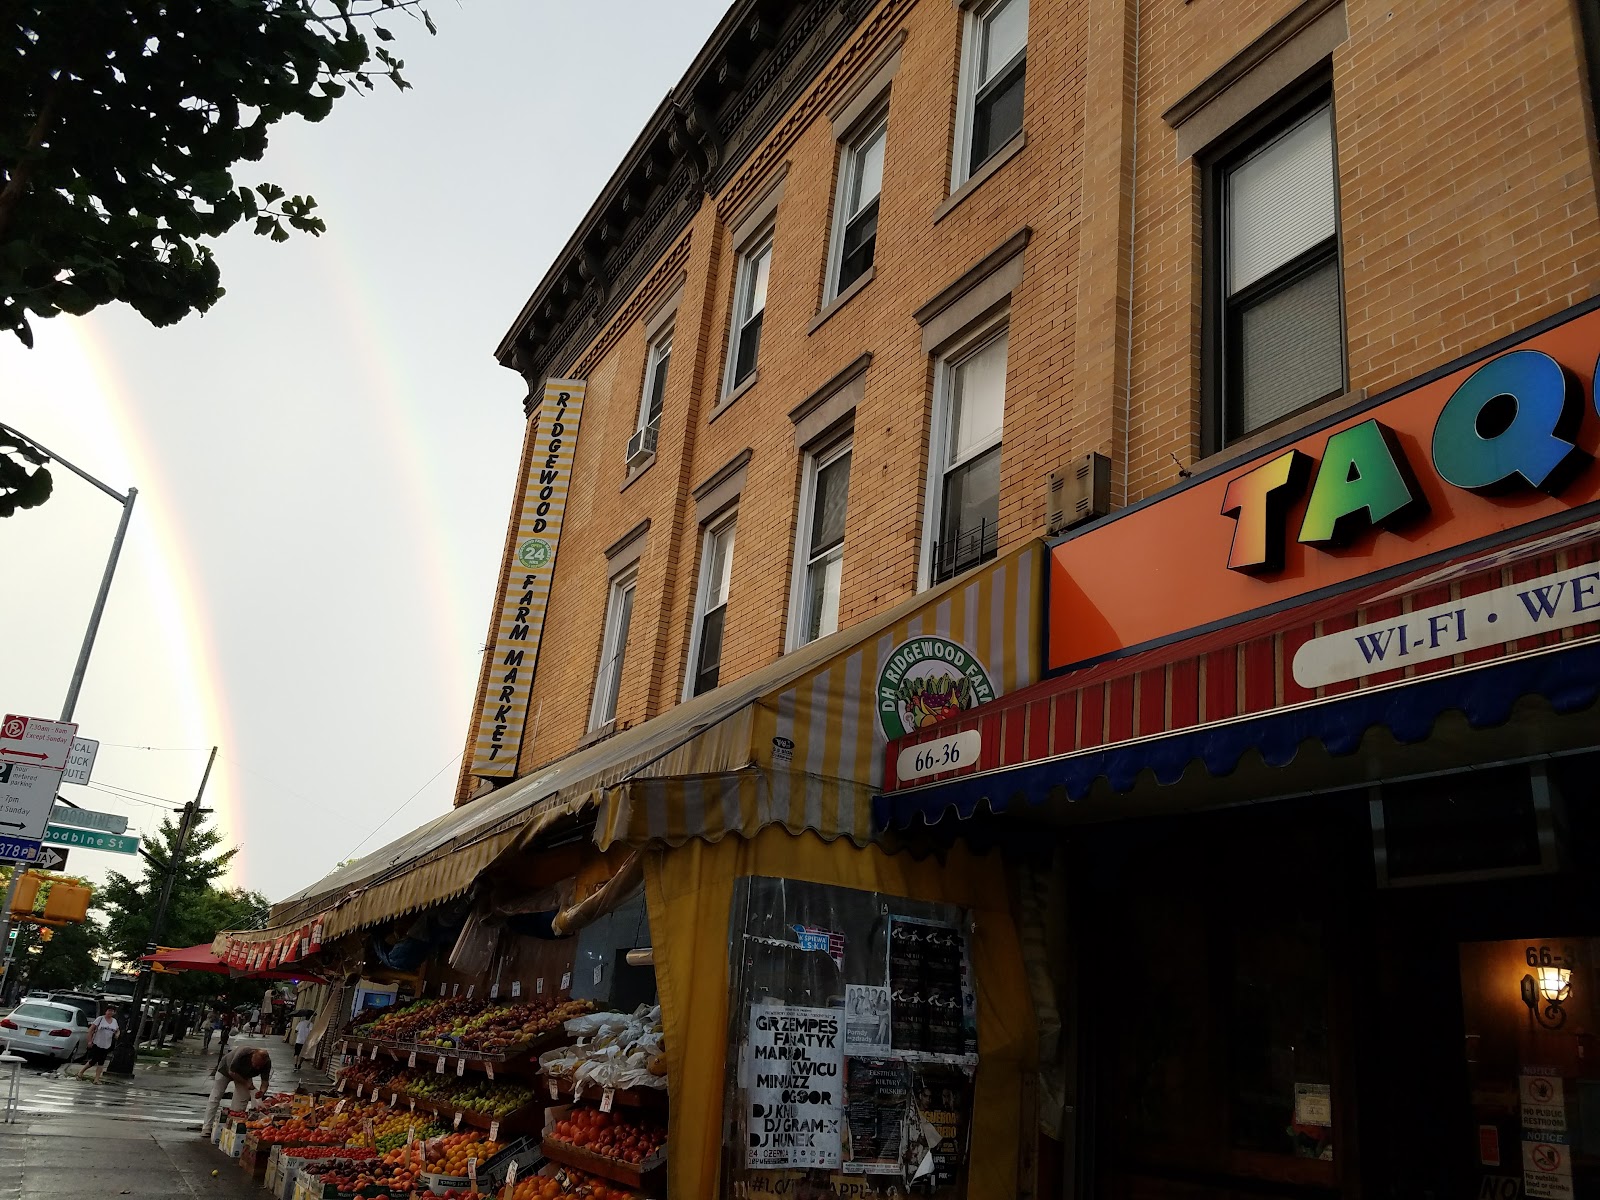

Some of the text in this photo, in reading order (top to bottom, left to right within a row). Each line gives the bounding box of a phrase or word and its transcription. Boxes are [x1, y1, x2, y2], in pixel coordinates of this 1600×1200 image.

[533, 392, 571, 533] RIDGEWOOD
[1220, 349, 1600, 570] TAQ
[524, 547, 545, 560] 24
[509, 574, 536, 641] FARM
[1355, 608, 1468, 664] WI-FI
[885, 641, 965, 684] RIDGEWOOD
[488, 650, 525, 761] MARKET
[882, 687, 896, 712] DH
[25, 732, 68, 744] Except Sunday
[70, 742, 92, 754] CAL
[67, 757, 89, 768] UCK
[915, 741, 960, 772] 66-36
[13, 773, 38, 781] metered
[63, 769, 86, 780] OUTE
[5, 795, 20, 804] 7pm
[5, 805, 31, 816] Sunday
[45, 831, 125, 849] oodbine St
[755, 1015, 839, 1035] GRZEMPEŚ
[774, 1032, 836, 1049] FANATYK
[790, 1061, 837, 1077] KWICU
[1522, 1066, 1558, 1076] NOTICE
[879, 1088, 907, 1096] POLSKIEJ
[753, 1104, 773, 1118] DJ
[1523, 1108, 1563, 1118] NO PUBLIC
[764, 1119, 838, 1133] DJ GRAM-X
[1523, 1117, 1564, 1127] RESTROOM
[750, 1133, 815, 1148] DJ HUNEK
[1526, 1131, 1564, 1143] NOTICE
[748, 1149, 758, 1157] 24
[1526, 1172, 1559, 1183] No outside
[1526, 1180, 1540, 1188] food
[1549, 1182, 1570, 1192] drinks
